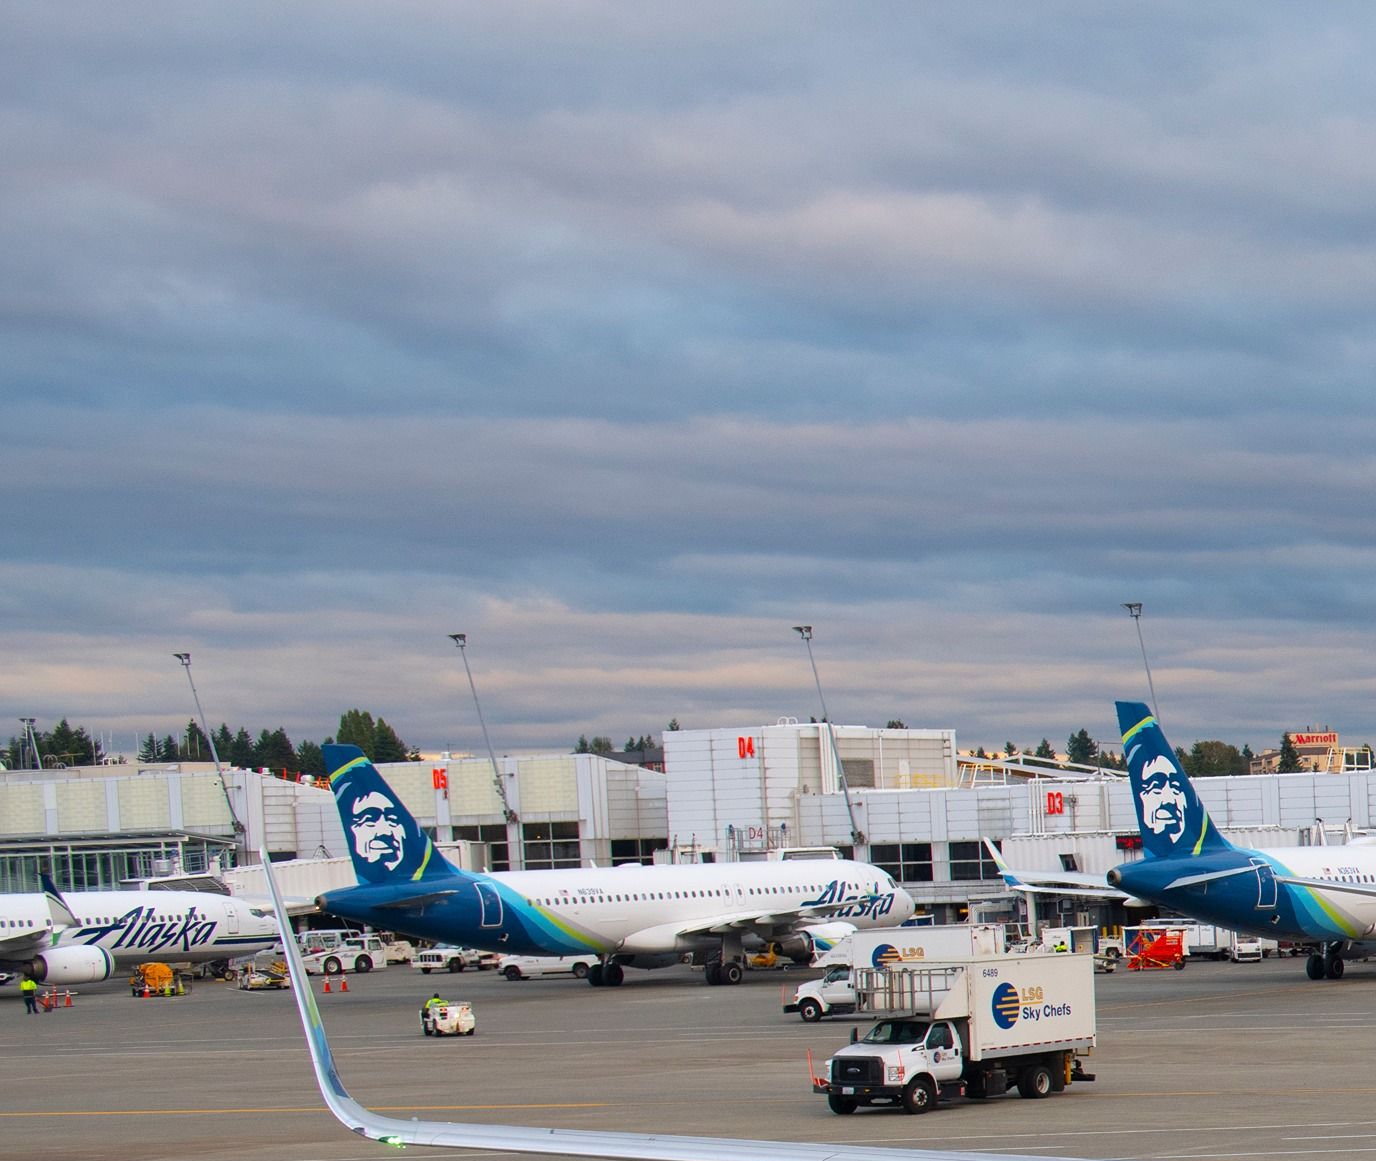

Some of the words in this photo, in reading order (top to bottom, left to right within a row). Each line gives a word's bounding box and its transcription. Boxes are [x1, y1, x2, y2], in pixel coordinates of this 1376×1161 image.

[1294, 733, 1336, 744] Marriott
[738, 736, 755, 759] D4
[432, 768, 447, 790] D5
[1047, 792, 1064, 815] D3
[749, 827, 764, 840] D4
[72, 906, 218, 953] Alaska
[902, 947, 925, 958] LSG
[982, 968, 998, 978] 6489
[1021, 986, 1043, 1001] LSG
[1022, 1007, 1041, 1021] Sky
[1043, 1003, 1072, 1017] Chefs
